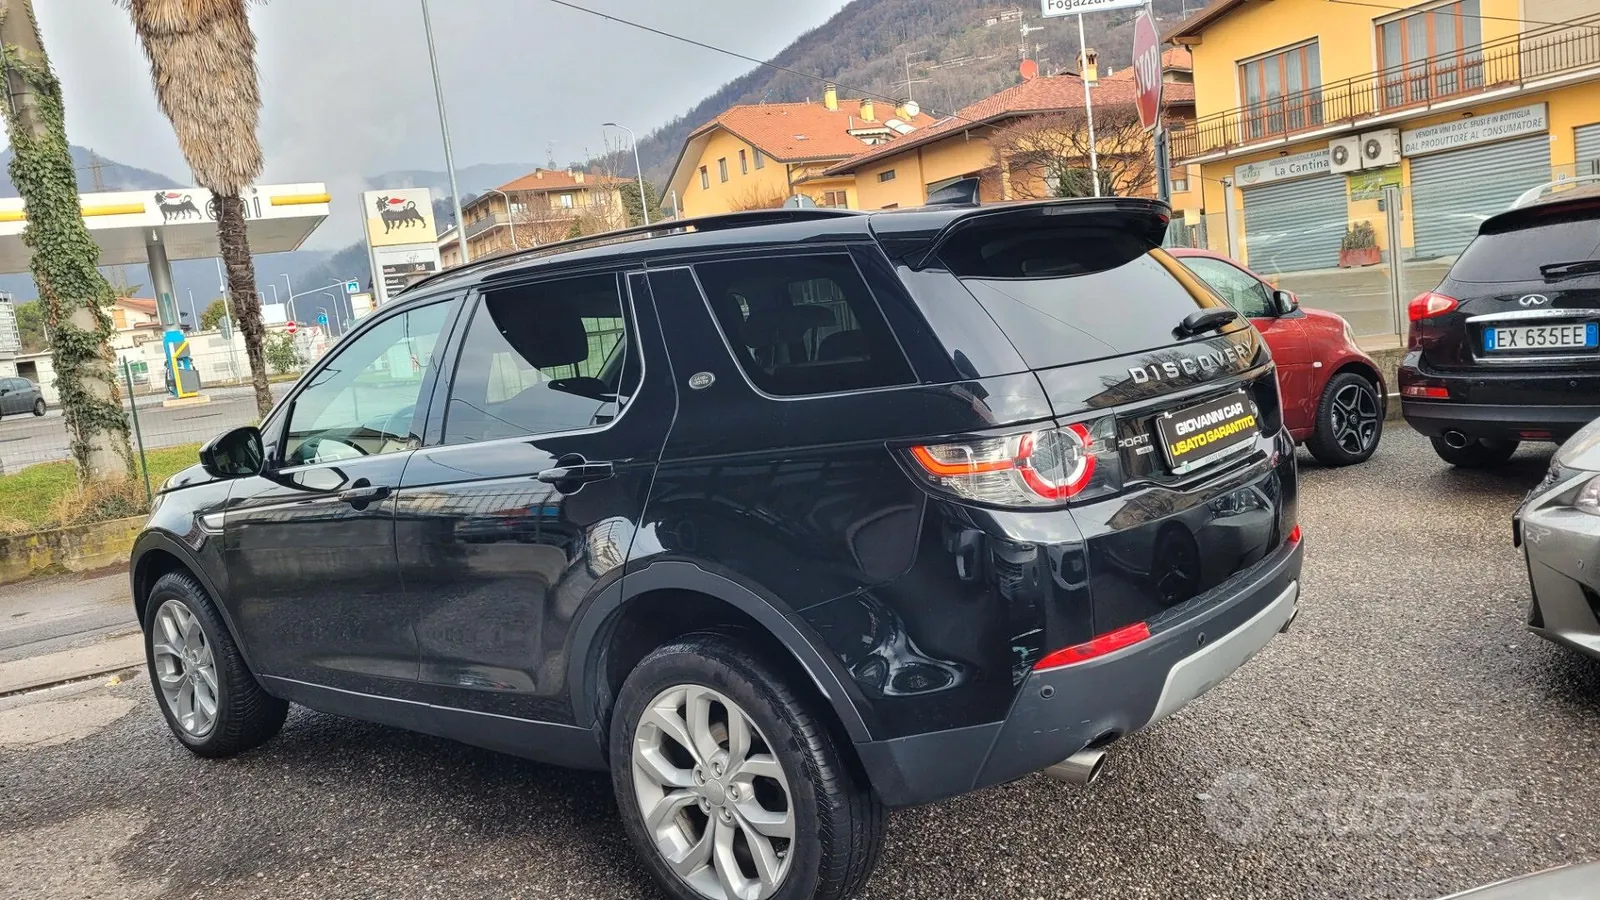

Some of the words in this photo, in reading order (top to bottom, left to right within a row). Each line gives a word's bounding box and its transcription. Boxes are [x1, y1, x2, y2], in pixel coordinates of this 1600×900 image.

[1134, 44, 1158, 98] STOP
[1405, 143, 1419, 152] DAL
[1421, 132, 1468, 149] PRODUTTORE
[1470, 130, 1479, 139] AL
[1482, 117, 1542, 137] CONSUMATORE
[1415, 130, 1438, 139] VENDITA
[1440, 126, 1451, 135] VINI
[1491, 115, 1499, 124] IN
[1500, 109, 1531, 121] BOTTIGLIA
[1274, 167, 1286, 176] La
[1289, 159, 1329, 173] Cantina
[1497, 330, 1518, 347] EX
[1526, 326, 1584, 346] 635EE
[1128, 340, 1253, 384] DISCOVERY
[1169, 433, 1207, 456] USATO
[1206, 415, 1256, 443] GARANTITO
[1175, 408, 1225, 436] GIOVANNI
[1223, 402, 1244, 418] CAR
[1118, 433, 1150, 447] PORT
